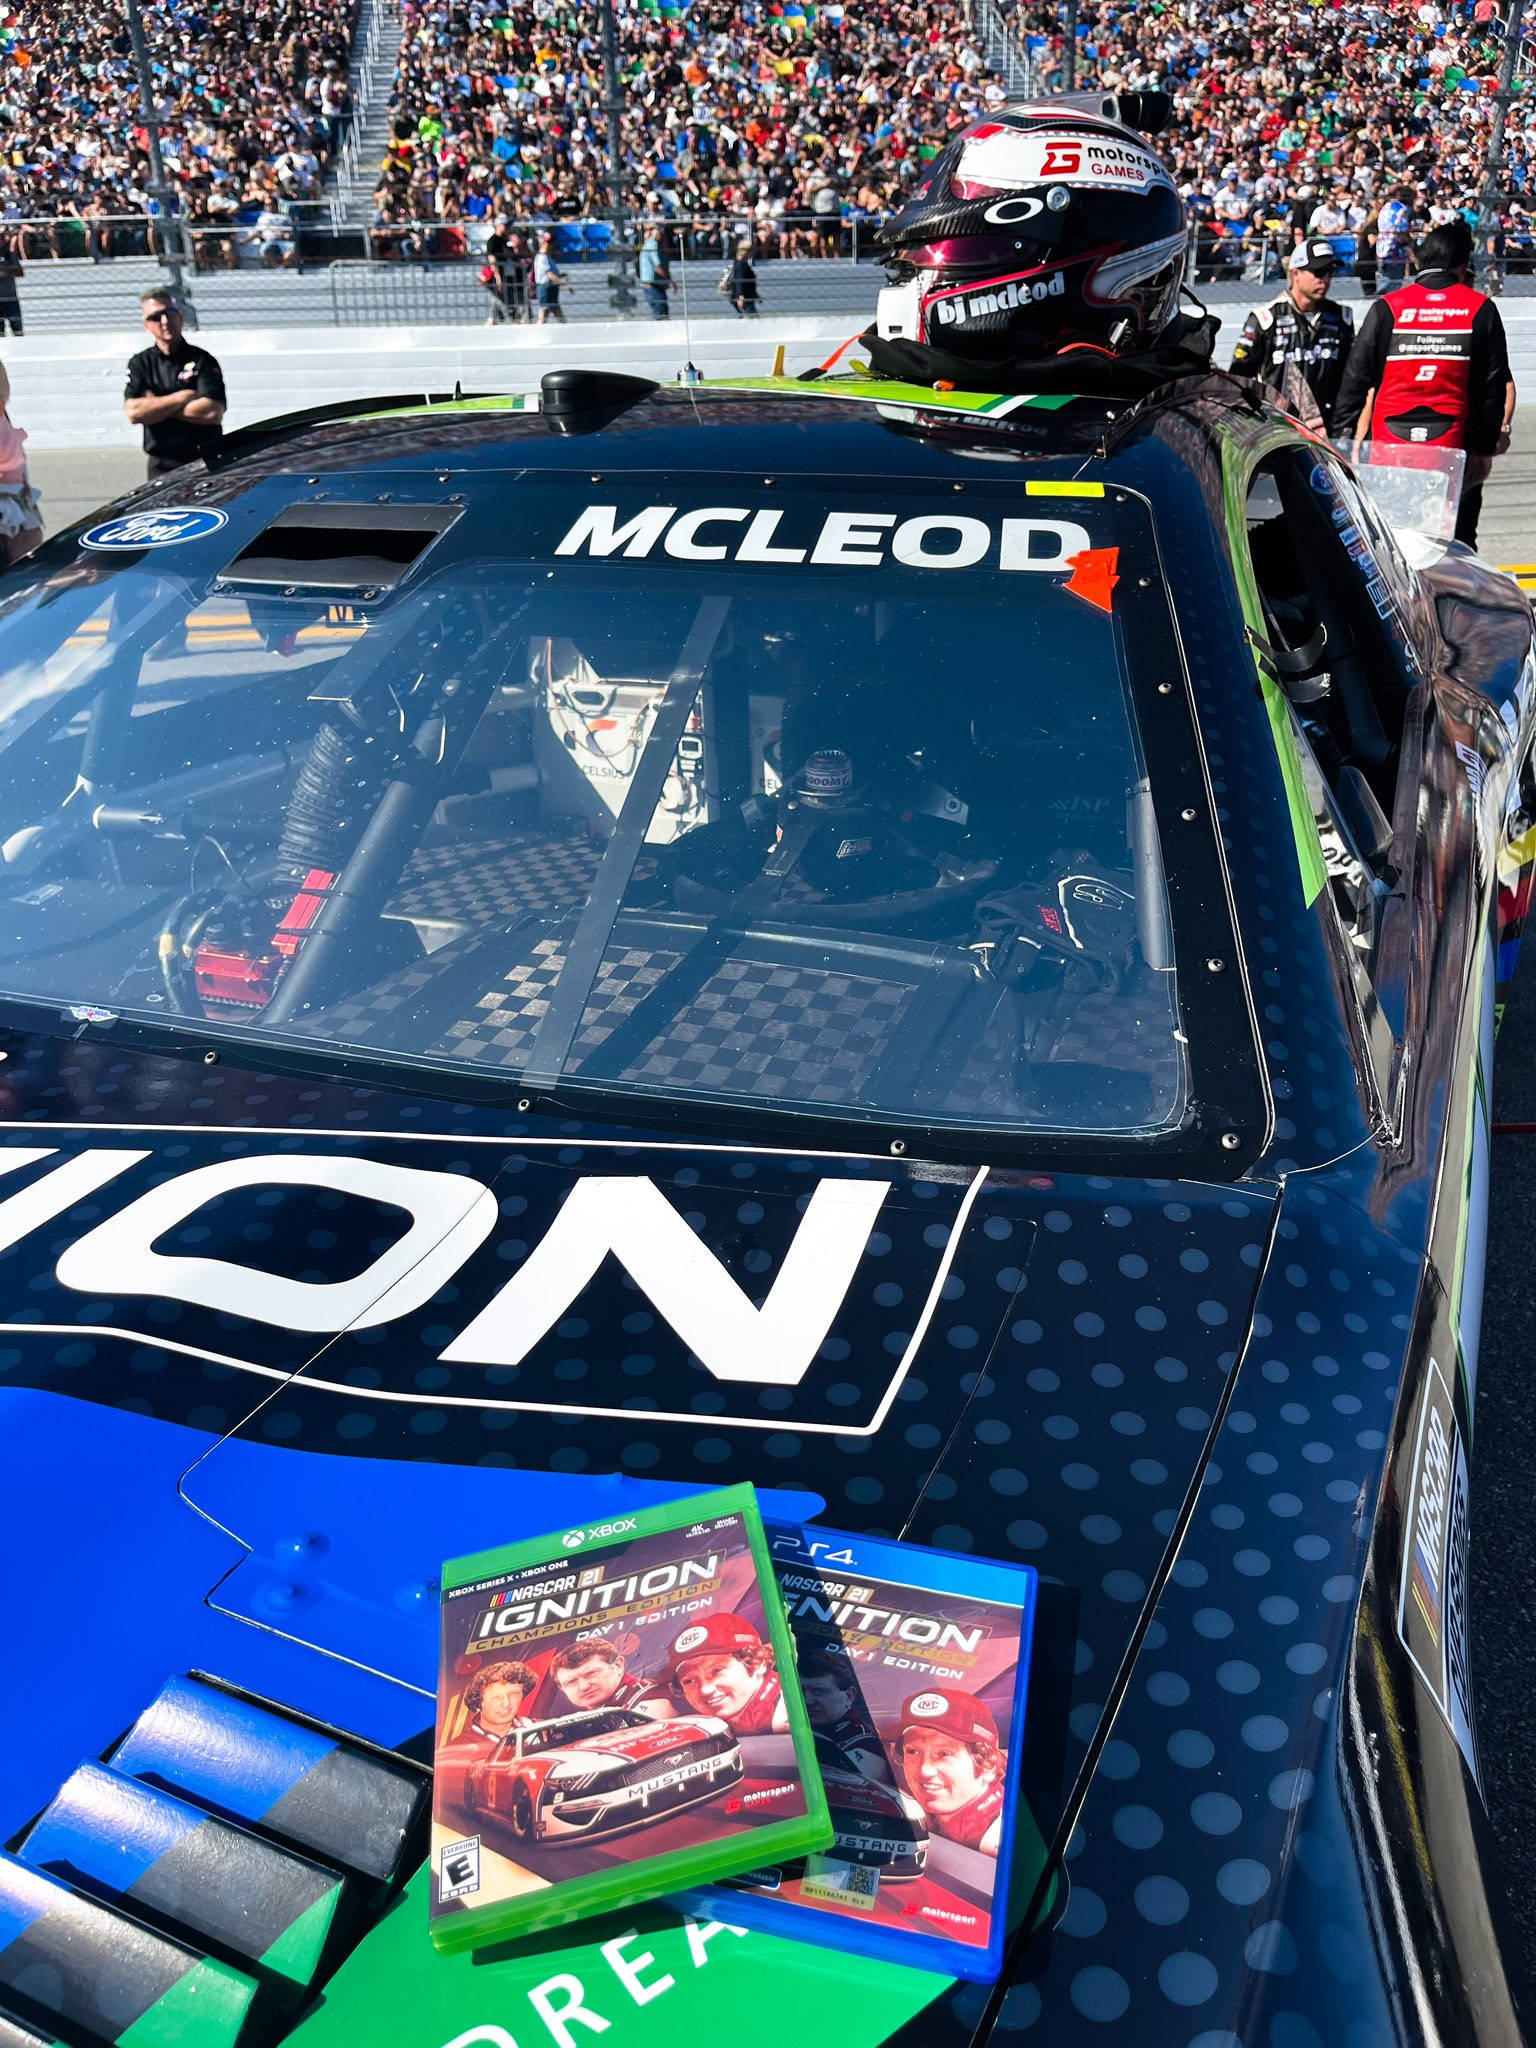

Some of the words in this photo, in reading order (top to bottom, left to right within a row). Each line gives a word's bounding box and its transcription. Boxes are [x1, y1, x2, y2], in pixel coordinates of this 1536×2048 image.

[1091, 163, 1145, 181] GAMES
[936, 296, 966, 325] bj
[968, 271, 1065, 318] mcleod
[1418, 307, 1469, 317] motorsport
[553, 505, 1091, 571] MCLEOD
[583, 765, 624, 779] CELSIUS
[1416, 1405, 1449, 1592] NASCAR
[588, 1517, 637, 1541] XBOX
[449, 1585, 475, 1599] XBOX
[476, 1577, 506, 1590] SERIES
[521, 1566, 547, 1578] XBOX
[548, 1560, 568, 1571] ONE
[478, 1554, 718, 1638] IGNITION
[511, 1575, 577, 1602] NASCAR
[582, 1569, 600, 1585] 21
[781, 1573, 846, 1597] NASCAR
[850, 1588, 869, 1602] 21
[475, 1611, 608, 1650] CHAMPIONS
[626, 1580, 714, 1613] EDITION
[575, 1623, 615, 1642] DAY
[617, 1621, 624, 1631] 1
[635, 1596, 713, 1626] EDITION
[825, 1643, 863, 1659] DAY
[867, 1650, 874, 1661] 1
[883, 1656, 964, 1680] EDITION
[628, 1757, 722, 1799] MUSTANG
[743, 1783, 795, 1803] motorsport
[446, 1854, 475, 1887] E
[922, 1906, 976, 1925] motorsport
